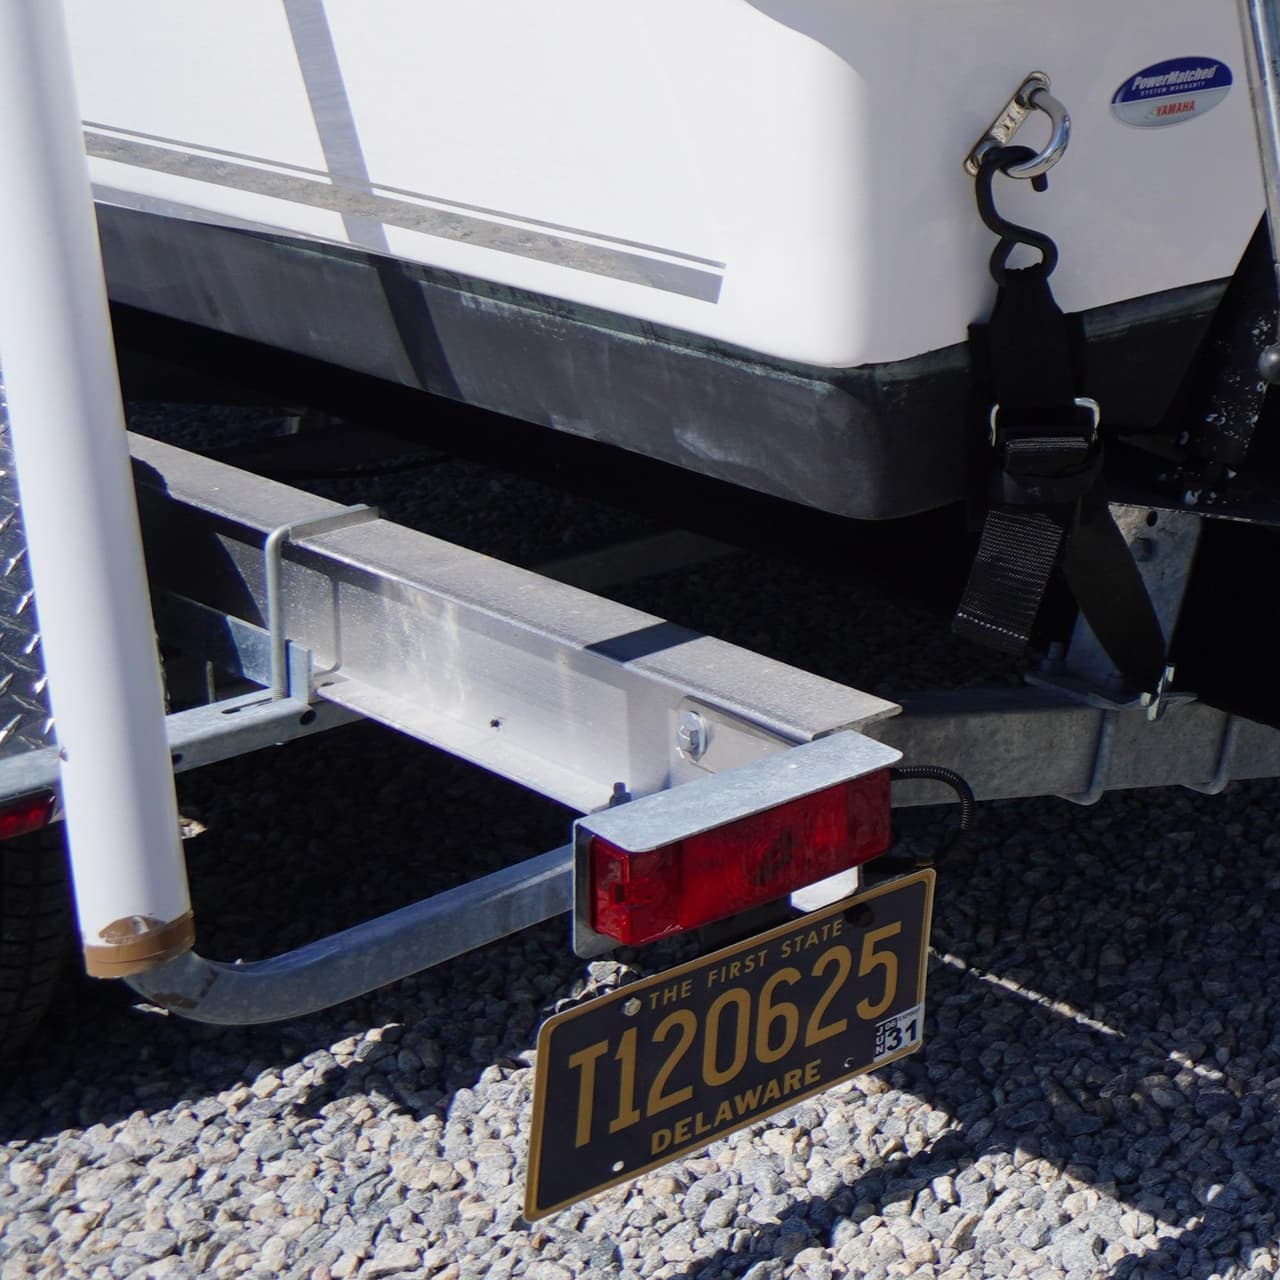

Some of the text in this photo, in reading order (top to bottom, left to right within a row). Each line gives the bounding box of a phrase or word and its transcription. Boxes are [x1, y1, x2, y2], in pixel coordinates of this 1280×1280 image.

[1131, 65, 1219, 91] PowerMatched
[1156, 101, 1195, 117] YAMAHA
[649, 919, 844, 1011] THE FIRST STATE
[568, 921, 903, 1149] T120625
[887, 1019, 917, 1051] 31
[650, 1058, 823, 1156] DELAWARE
